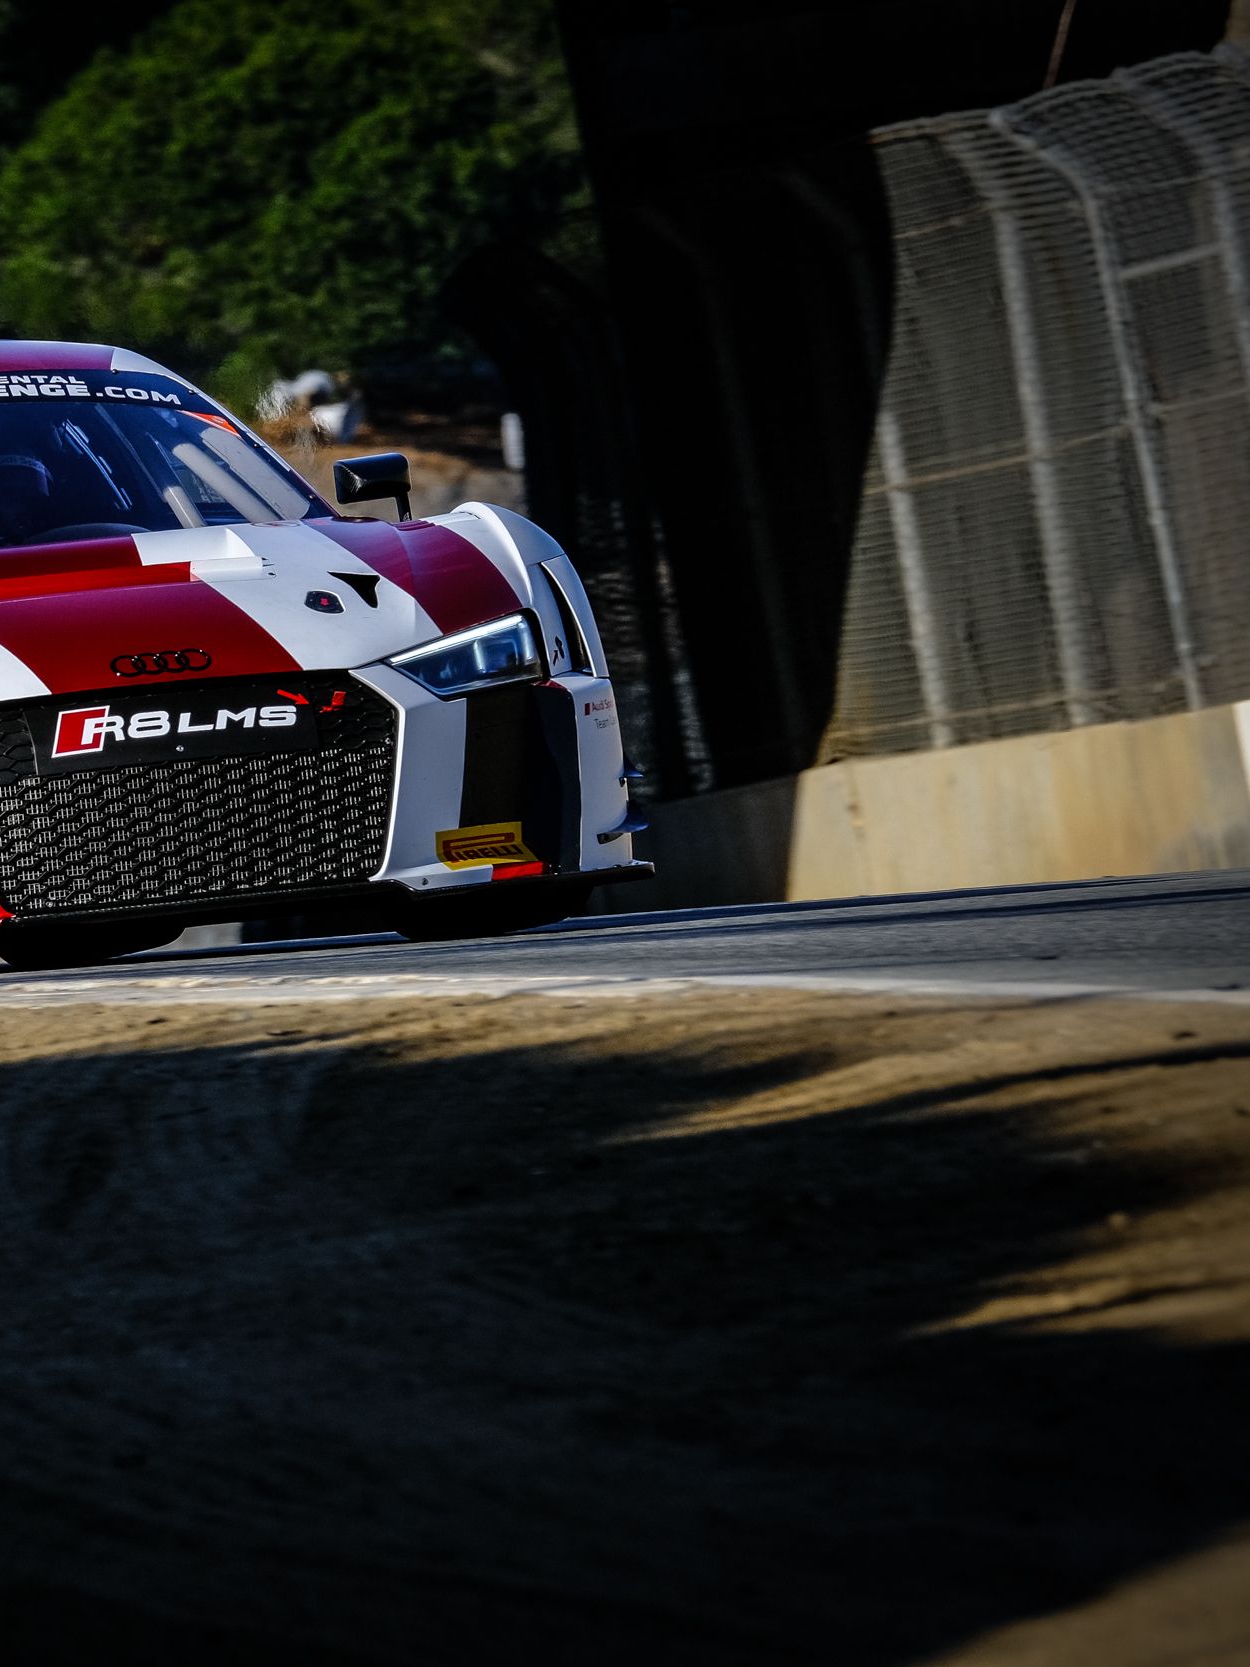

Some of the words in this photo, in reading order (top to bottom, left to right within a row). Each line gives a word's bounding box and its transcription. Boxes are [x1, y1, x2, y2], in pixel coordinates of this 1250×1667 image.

[81, 710, 171, 746] R8
[177, 705, 297, 733] LMS
[442, 832, 524, 863] PIRELLI
